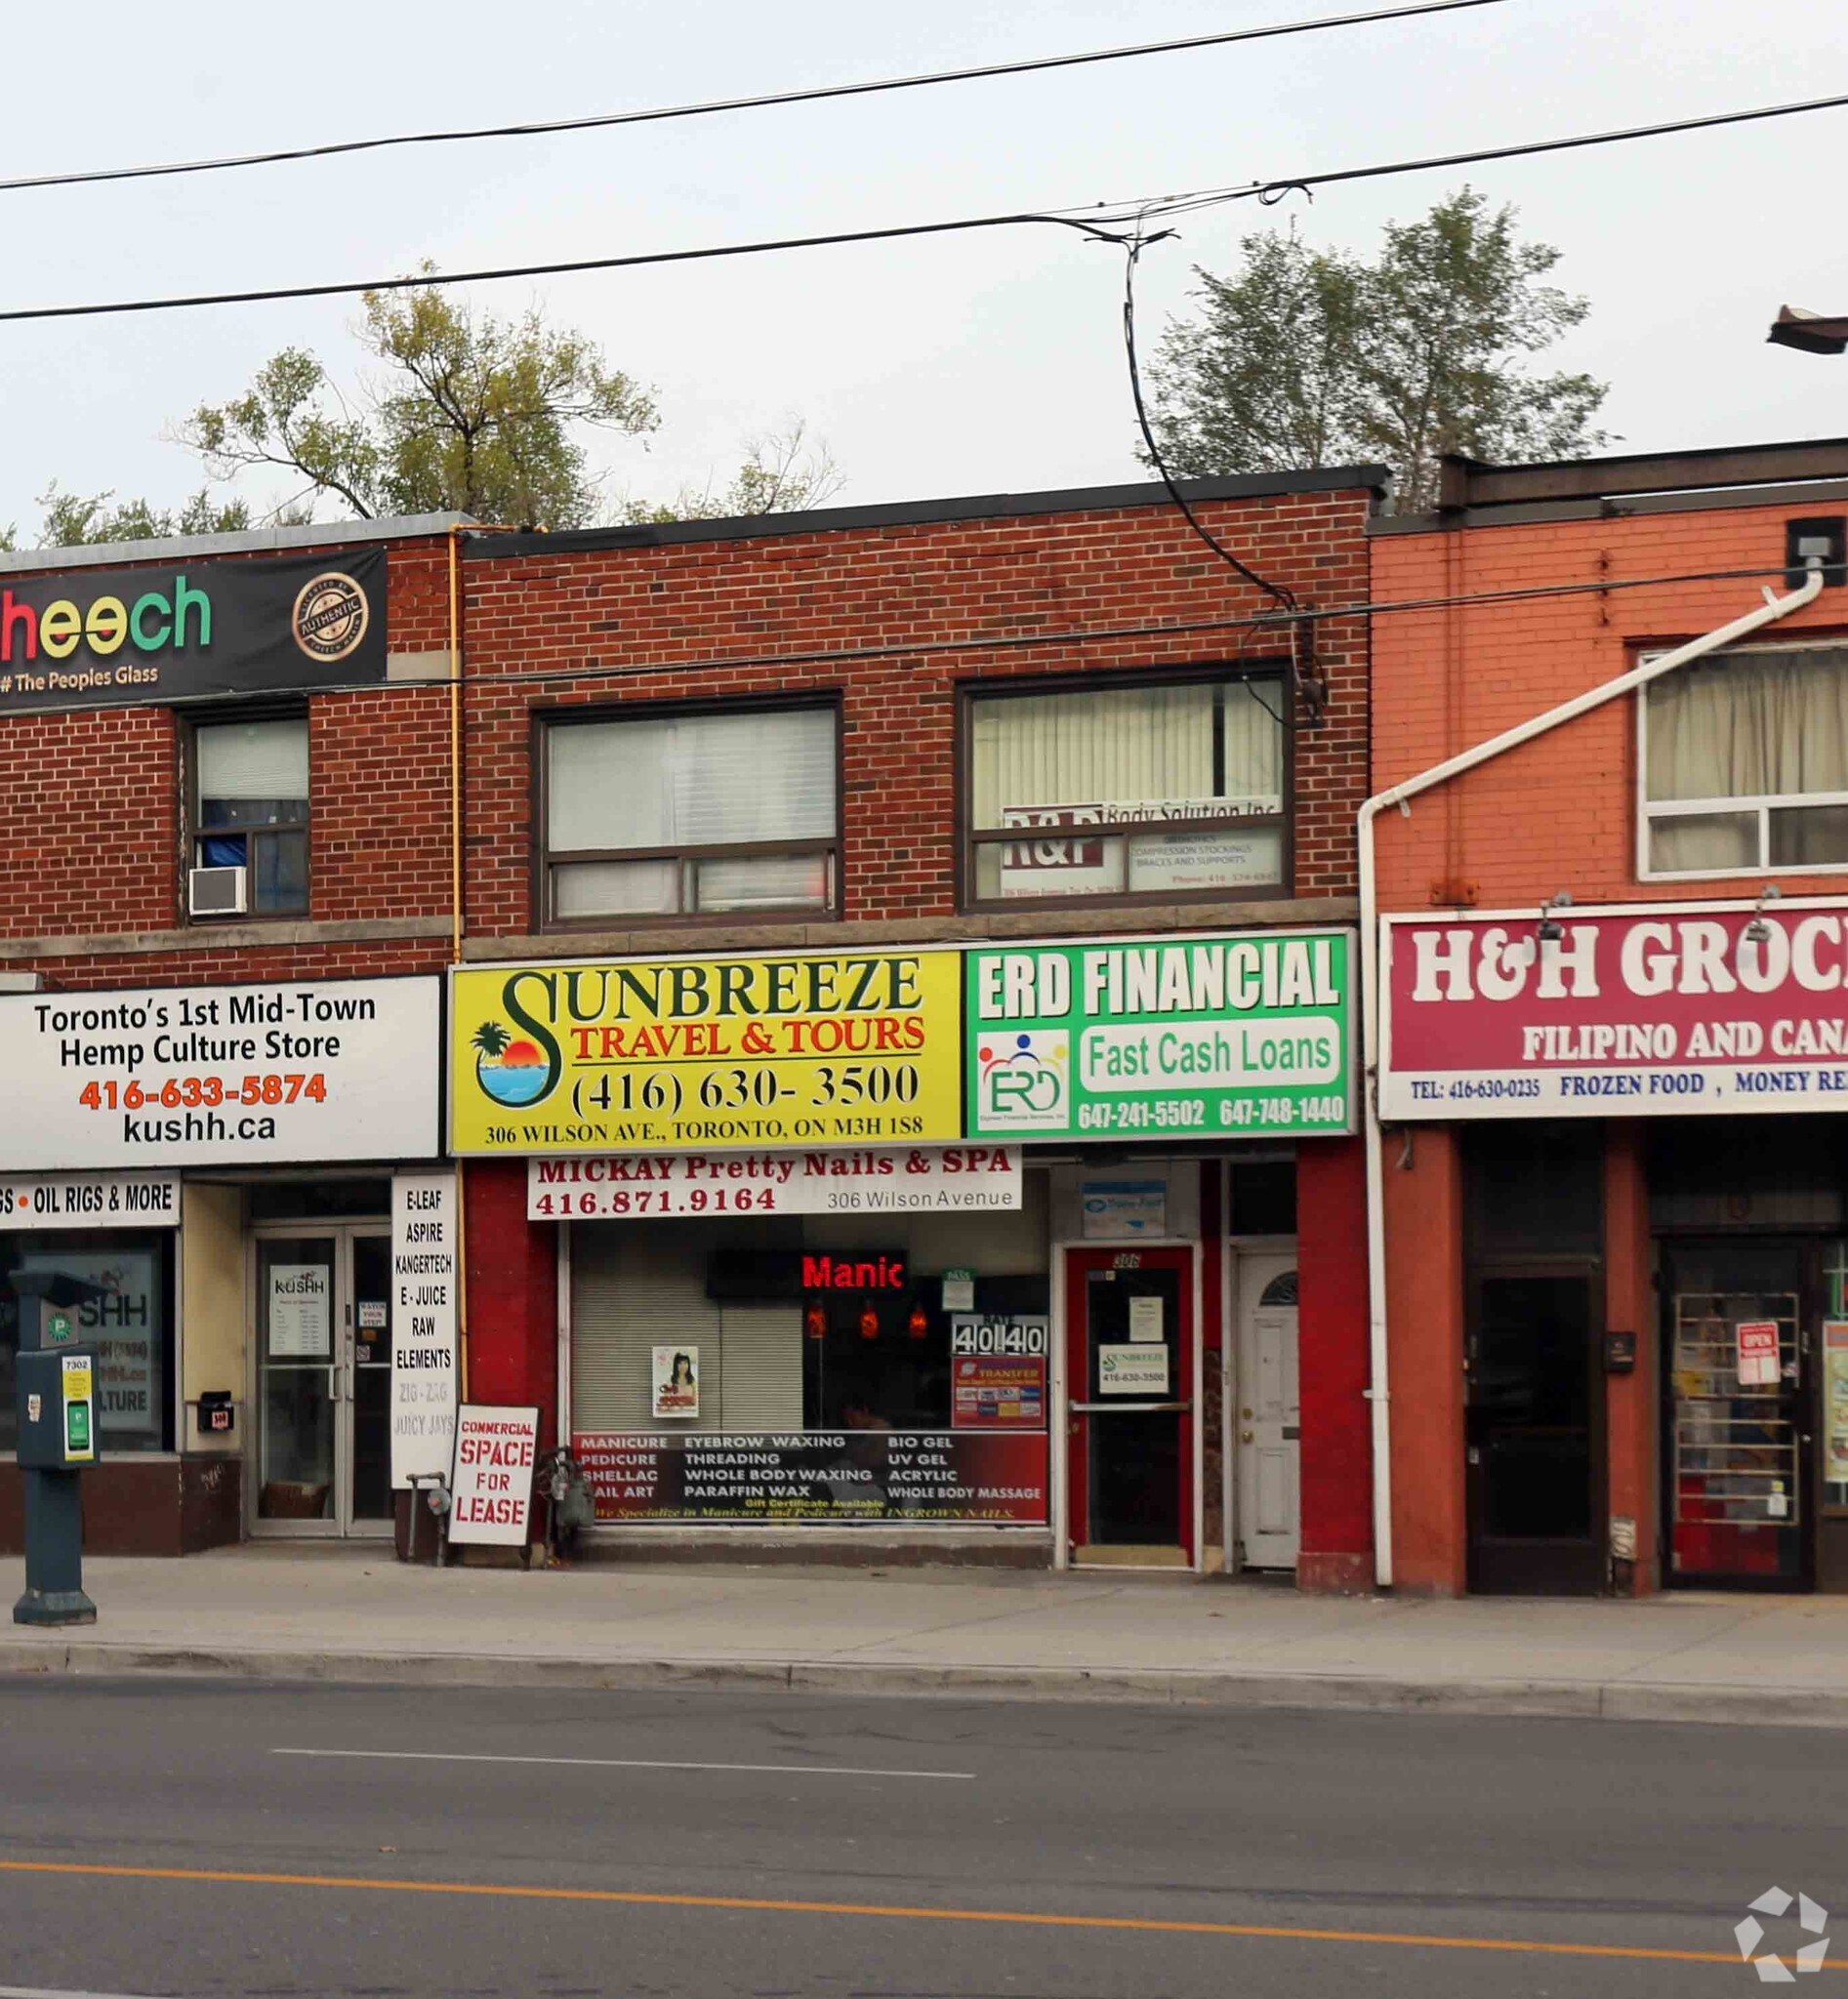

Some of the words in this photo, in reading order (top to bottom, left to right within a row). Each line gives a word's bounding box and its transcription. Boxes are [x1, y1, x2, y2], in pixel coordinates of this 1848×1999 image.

[302, 597, 359, 635] AUTHENTIC
[16, 673, 45, 692] The
[49, 668, 111, 691] Peoples
[115, 665, 158, 684] Glass
[1412, 924, 1601, 1002] H&H
[1621, 916, 1848, 997] GROC
[978, 953, 1071, 1020] ERD
[1083, 940, 1339, 1016] FINANCIAL
[179, 998, 220, 1027] 1st
[229, 993, 376, 1025] Mid-Town
[570, 1022, 731, 1061] TRAVEL
[741, 1021, 776, 1054] &
[783, 1016, 925, 1051] TOURS
[1522, 1023, 1678, 1061] FILIPINO
[1685, 1020, 1764, 1058] AND
[1771, 1017, 1848, 1056] CAN
[61, 1037, 144, 1073] Hemp
[153, 1033, 257, 1065] Culture
[266, 1030, 341, 1060] Store
[1089, 1035, 1149, 1077] Fast
[1159, 1031, 1230, 1073] Cash
[1242, 1030, 1332, 1071] Loans
[79, 1074, 327, 1111] 416-633-5874
[572, 1071, 683, 1119] (416)
[811, 1064, 919, 1106] 3500
[992, 1071, 1060, 1112] ERD
[1412, 1080, 1444, 1100] TEL:
[1450, 1079, 1540, 1100] 416-630-0235
[1560, 1076, 1641, 1097] FROZEN
[1650, 1074, 1704, 1094] FOOD
[1736, 1071, 1809, 1093] MONEY
[1818, 1070, 1848, 1091] RE
[1078, 1100, 1205, 1129] 647-241-5502
[1219, 1096, 1344, 1125] 647-748-1440
[124, 1112, 276, 1143] kushh.ca
[485, 1126, 516, 1144] 306
[521, 1123, 608, 1143] WILSON
[613, 1122, 667, 1143] AVE.,
[672, 1120, 787, 1141] TORONTO,
[794, 1119, 827, 1138] ON
[833, 1117, 881, 1136] M3H
[889, 1116, 924, 1135] 1S8
[538, 1158, 676, 1184] MICKAY
[685, 1157, 795, 1184] Pretty
[803, 1151, 893, 1176] Nails
[905, 1150, 930, 1174] &
[942, 1148, 1011, 1173] SPA
[34, 1187, 60, 1213] OIL
[65, 1185, 103, 1212] RIGS
[108, 1184, 119, 1211] &
[125, 1184, 173, 1211] MORE
[407, 1191, 441, 1210] E-LEAF
[536, 1188, 776, 1216] 416.871.9164
[828, 1193, 861, 1210] 306
[866, 1190, 933, 1209] Wilson
[935, 1189, 1012, 1208] Avenue
[406, 1223, 443, 1243] ASPIRE
[395, 1254, 452, 1275] KANGERTECH
[802, 1256, 904, 1287] Manic
[275, 1278, 324, 1294] KUSHH
[79, 1293, 146, 1326] SHH
[412, 1317, 435, 1337] RAW
[66, 1361, 88, 1370] 7302
[397, 1349, 451, 1368] ELEMENTS
[462, 1421, 533, 1436] COMMERCIAL
[460, 1439, 533, 1467] SPACE
[581, 1437, 668, 1449] MANICURE
[685, 1436, 764, 1448] EYEBROW
[772, 1436, 845, 1448] WAXING
[888, 1437, 918, 1448] BIO
[924, 1437, 954, 1448] GEL
[581, 1453, 657, 1465] PEDICURE
[685, 1453, 780, 1465] THREADING
[888, 1454, 914, 1465] UV
[918, 1454, 948, 1465] GEL
[476, 1472, 510, 1490] FOR
[583, 1470, 658, 1482] SHELLAC
[685, 1470, 745, 1481] WHOLE
[750, 1470, 796, 1481] BODY
[799, 1469, 873, 1481] WAXING
[888, 1470, 958, 1482] ACRYLIC
[595, 1487, 619, 1497] AIL
[623, 1487, 654, 1498] ART
[685, 1486, 763, 1497] PARAFFIN
[768, 1486, 810, 1497] WAX
[745, 1498, 767, 1507] Gift
[769, 1498, 829, 1508] Certificate
[832, 1498, 884, 1508] Available
[888, 1488, 934, 1498] WHOLE
[938, 1488, 973, 1499] BODY
[978, 1489, 1042, 1499] MASSAGE
[456, 1496, 524, 1525] LEASE
